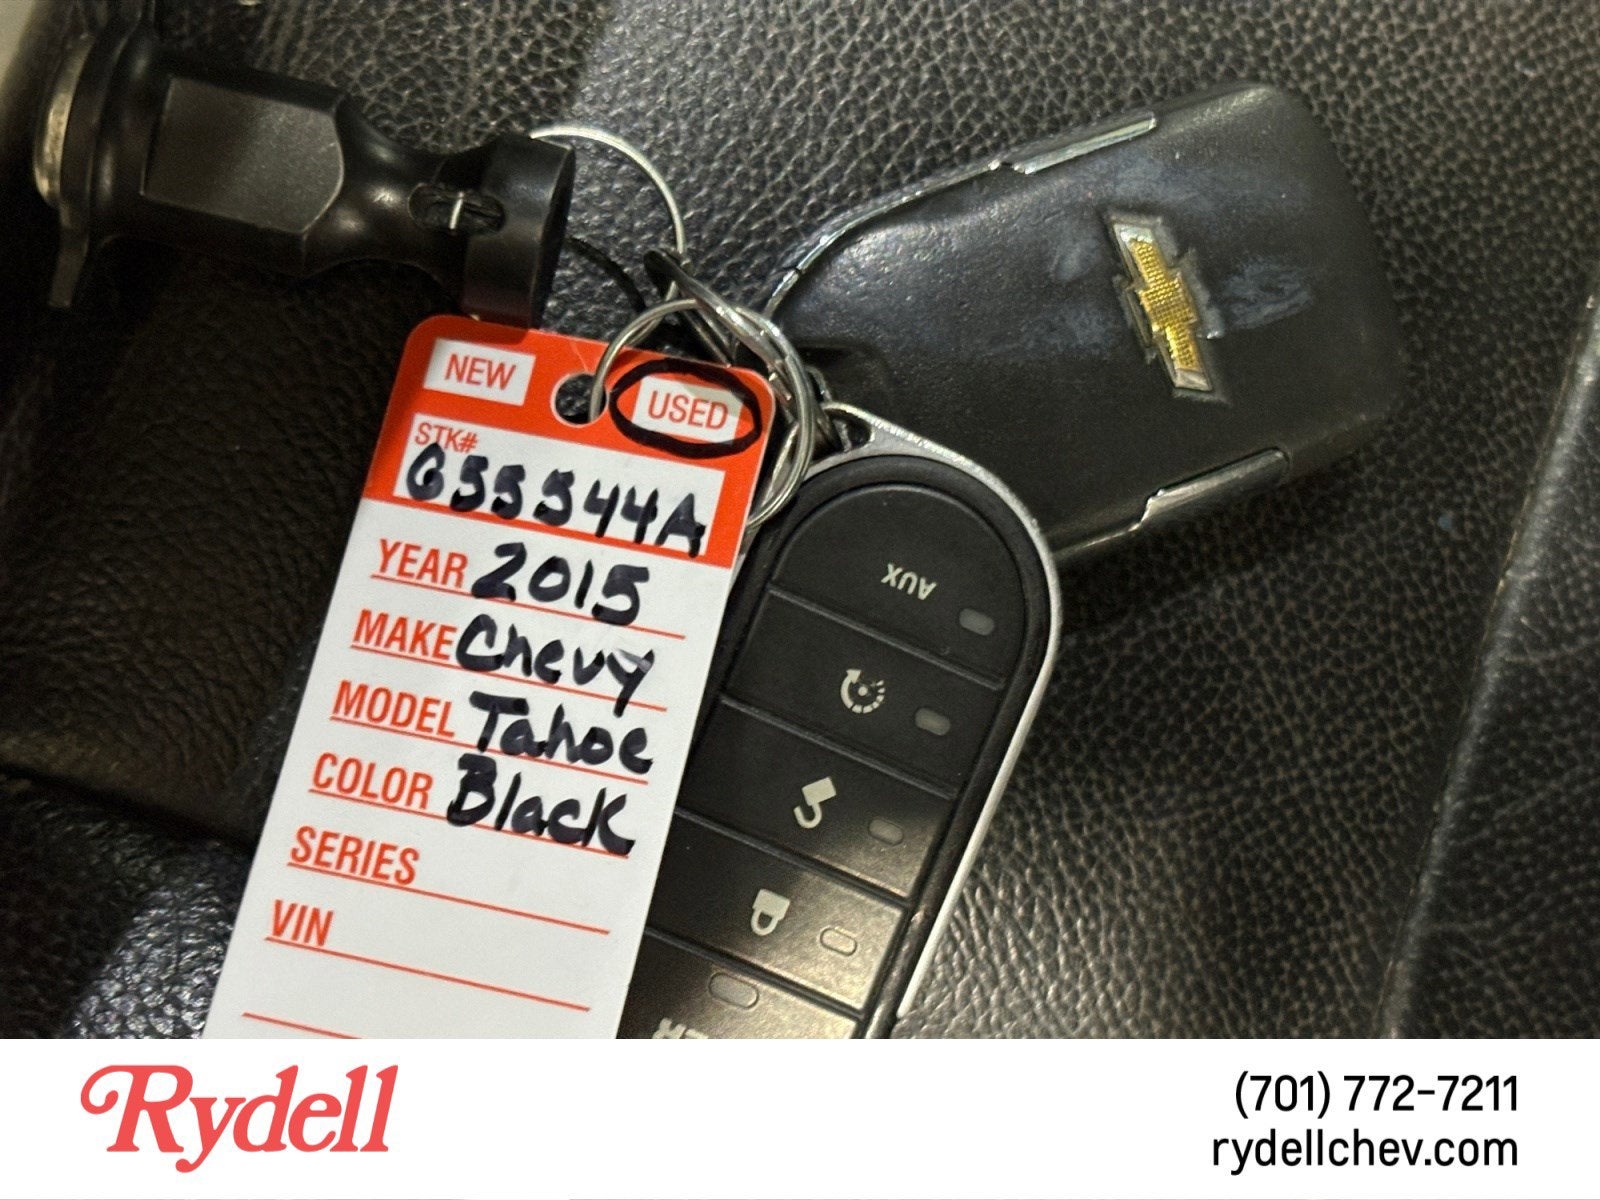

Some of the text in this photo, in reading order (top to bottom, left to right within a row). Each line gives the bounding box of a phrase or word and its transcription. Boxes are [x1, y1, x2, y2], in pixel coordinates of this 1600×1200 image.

[445, 353, 517, 390] NEW
[415, 422, 477, 453] STK#
[648, 391, 728, 431] USED
[380, 540, 468, 588] YEAR
[471, 542, 649, 625] 2015
[881, 563, 937, 600] AUX
[352, 609, 457, 660] MAKE
[456, 614, 655, 718] Chevy
[332, 680, 455, 738] MODEL
[469, 691, 653, 774] Tahoe
[312, 752, 433, 809] COLOR
[447, 753, 636, 856] Black
[290, 826, 419, 885] SERIES
[272, 900, 334, 947] VIN
